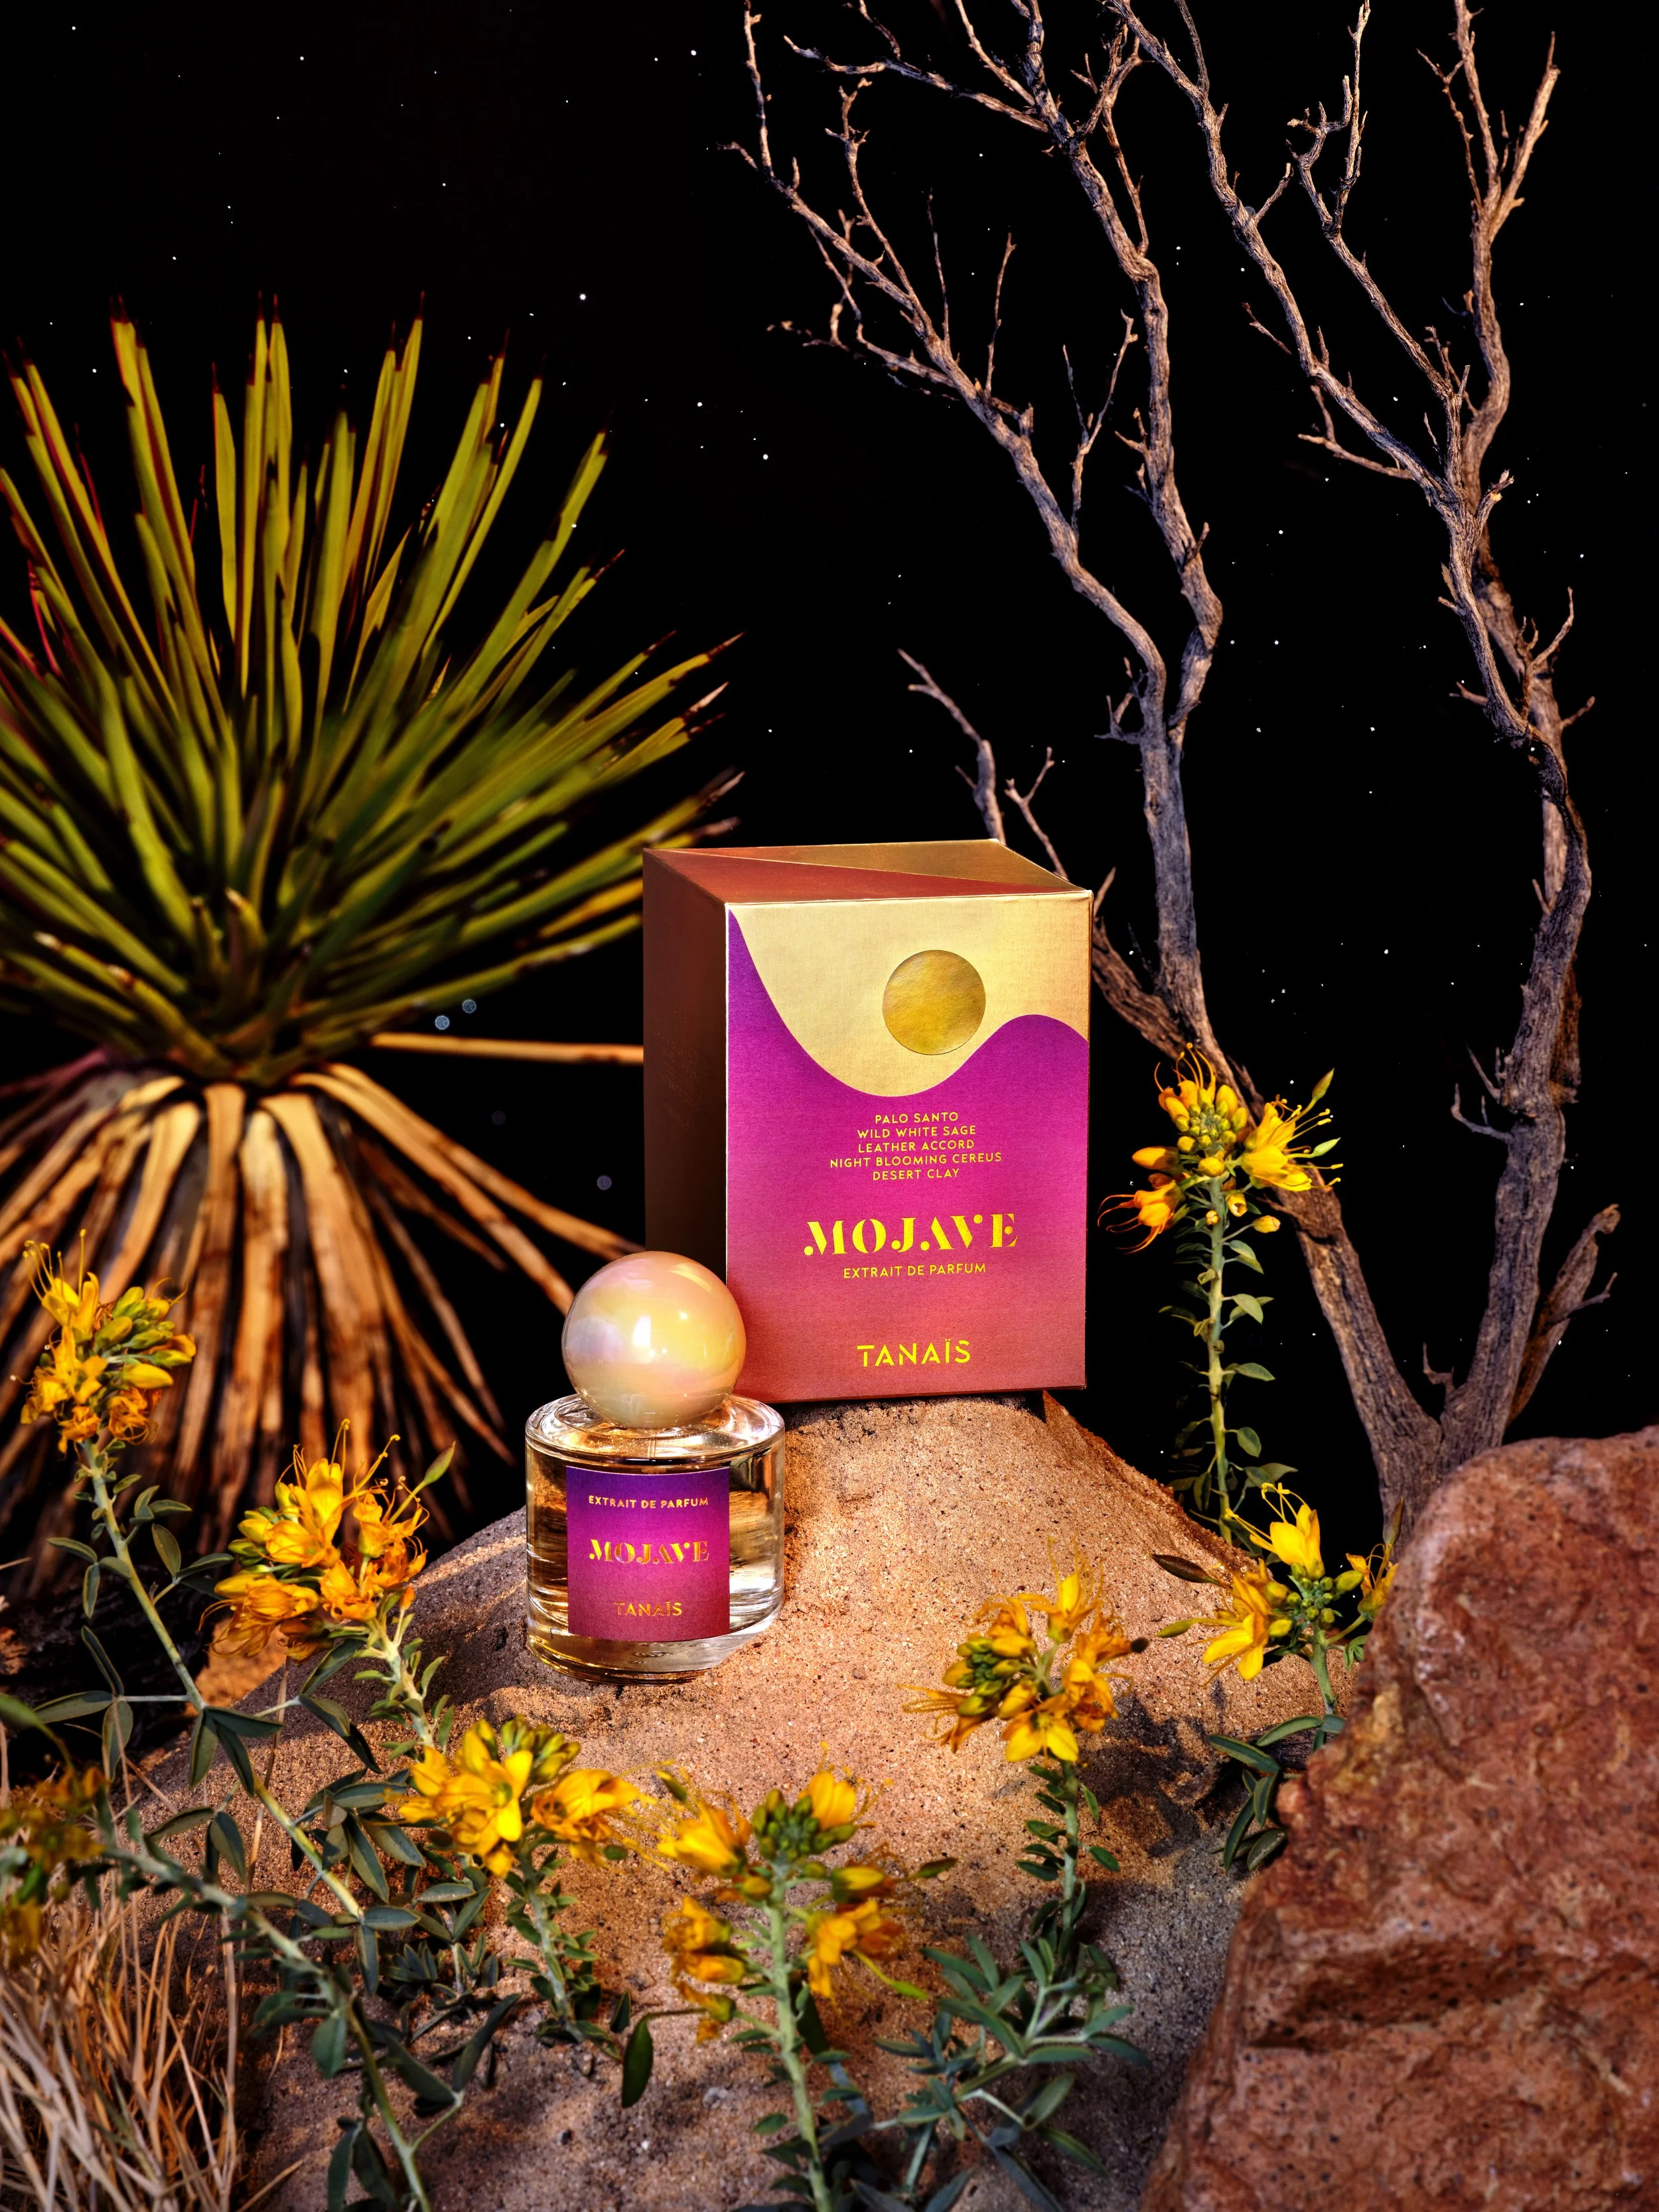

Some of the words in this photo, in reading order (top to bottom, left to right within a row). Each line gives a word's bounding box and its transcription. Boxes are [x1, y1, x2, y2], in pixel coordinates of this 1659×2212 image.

[875, 1113, 908, 1124] PALO
[913, 1111, 958, 1123] SANTO
[857, 1128, 891, 1139] WILD
[895, 1126, 938, 1138] WHITE
[943, 1125, 976, 1136] SAGE
[858, 1142, 916, 1153] LEATHER
[921, 1139, 975, 1151] ACCORD
[830, 1157, 871, 1168] NIGHT
[875, 1155, 947, 1166] BLOOMING
[952, 1152, 1001, 1163] CEREUS
[873, 1169, 922, 1181] DESERT
[926, 1167, 960, 1179] CLAY
[804, 1213, 1017, 1256] MOJAVE
[843, 1266, 903, 1279] EXTRAIT
[907, 1264, 924, 1276] DE
[930, 1262, 986, 1275] PARFUM
[857, 1338, 971, 1367] TANAÏS
[589, 1495, 637, 1509] EXTRAIT
[640, 1499, 656, 1509] DE
[660, 1497, 708, 1509] PARFUM
[589, 1539, 709, 1565] MOJAVE
